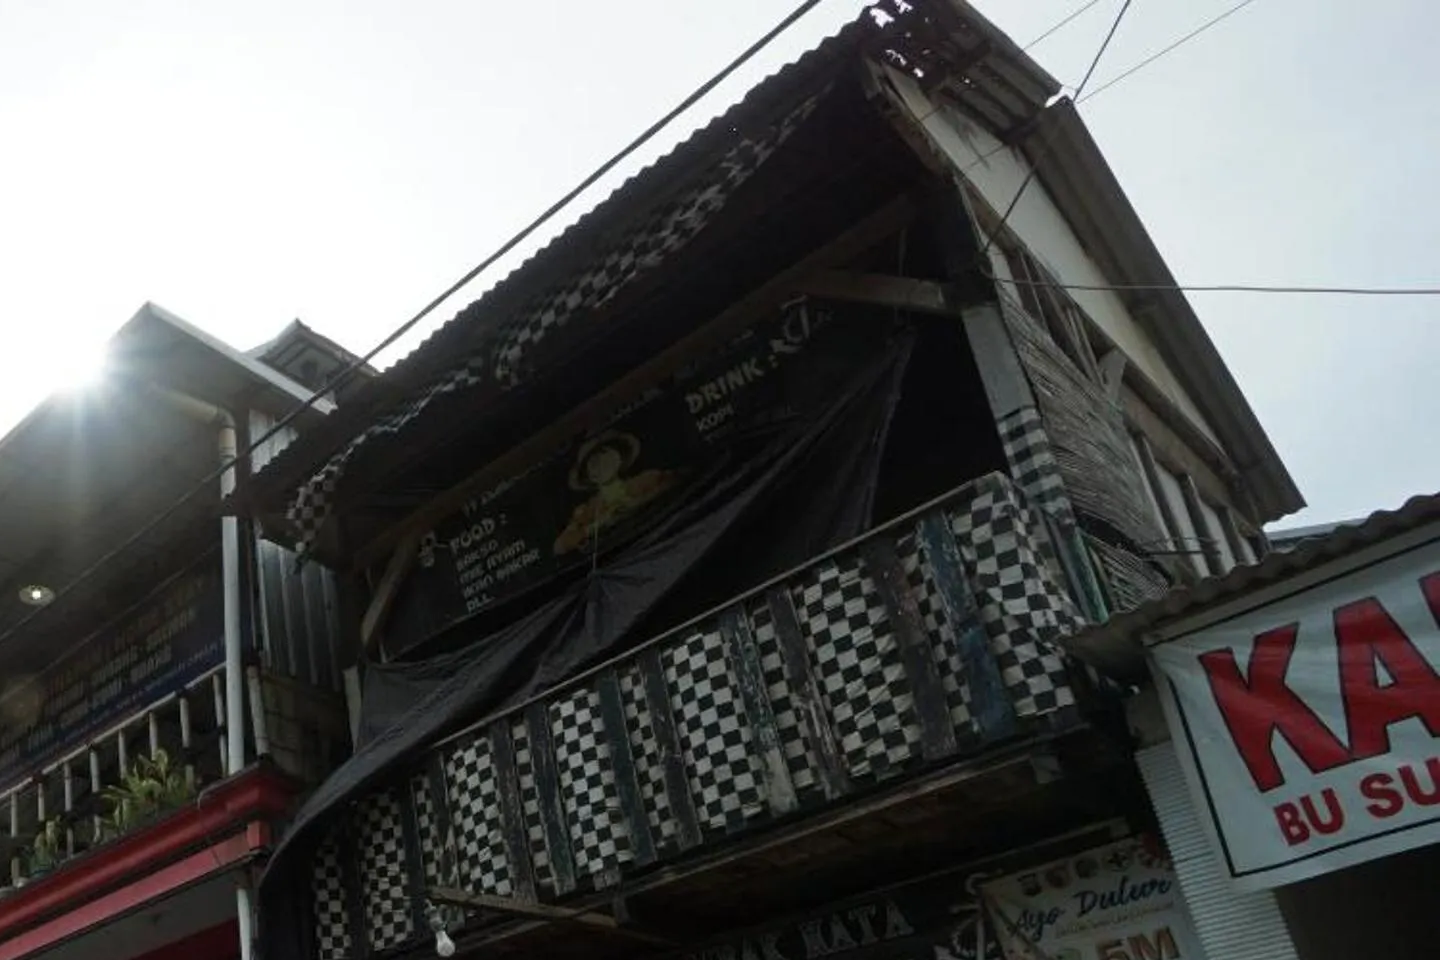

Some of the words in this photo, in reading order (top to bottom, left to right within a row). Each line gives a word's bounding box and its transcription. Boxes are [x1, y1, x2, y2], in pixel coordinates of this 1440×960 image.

[696, 405, 735, 432] KOPI
[1197, 571, 1440, 792] KA
[1274, 788, 1344, 846] BU
